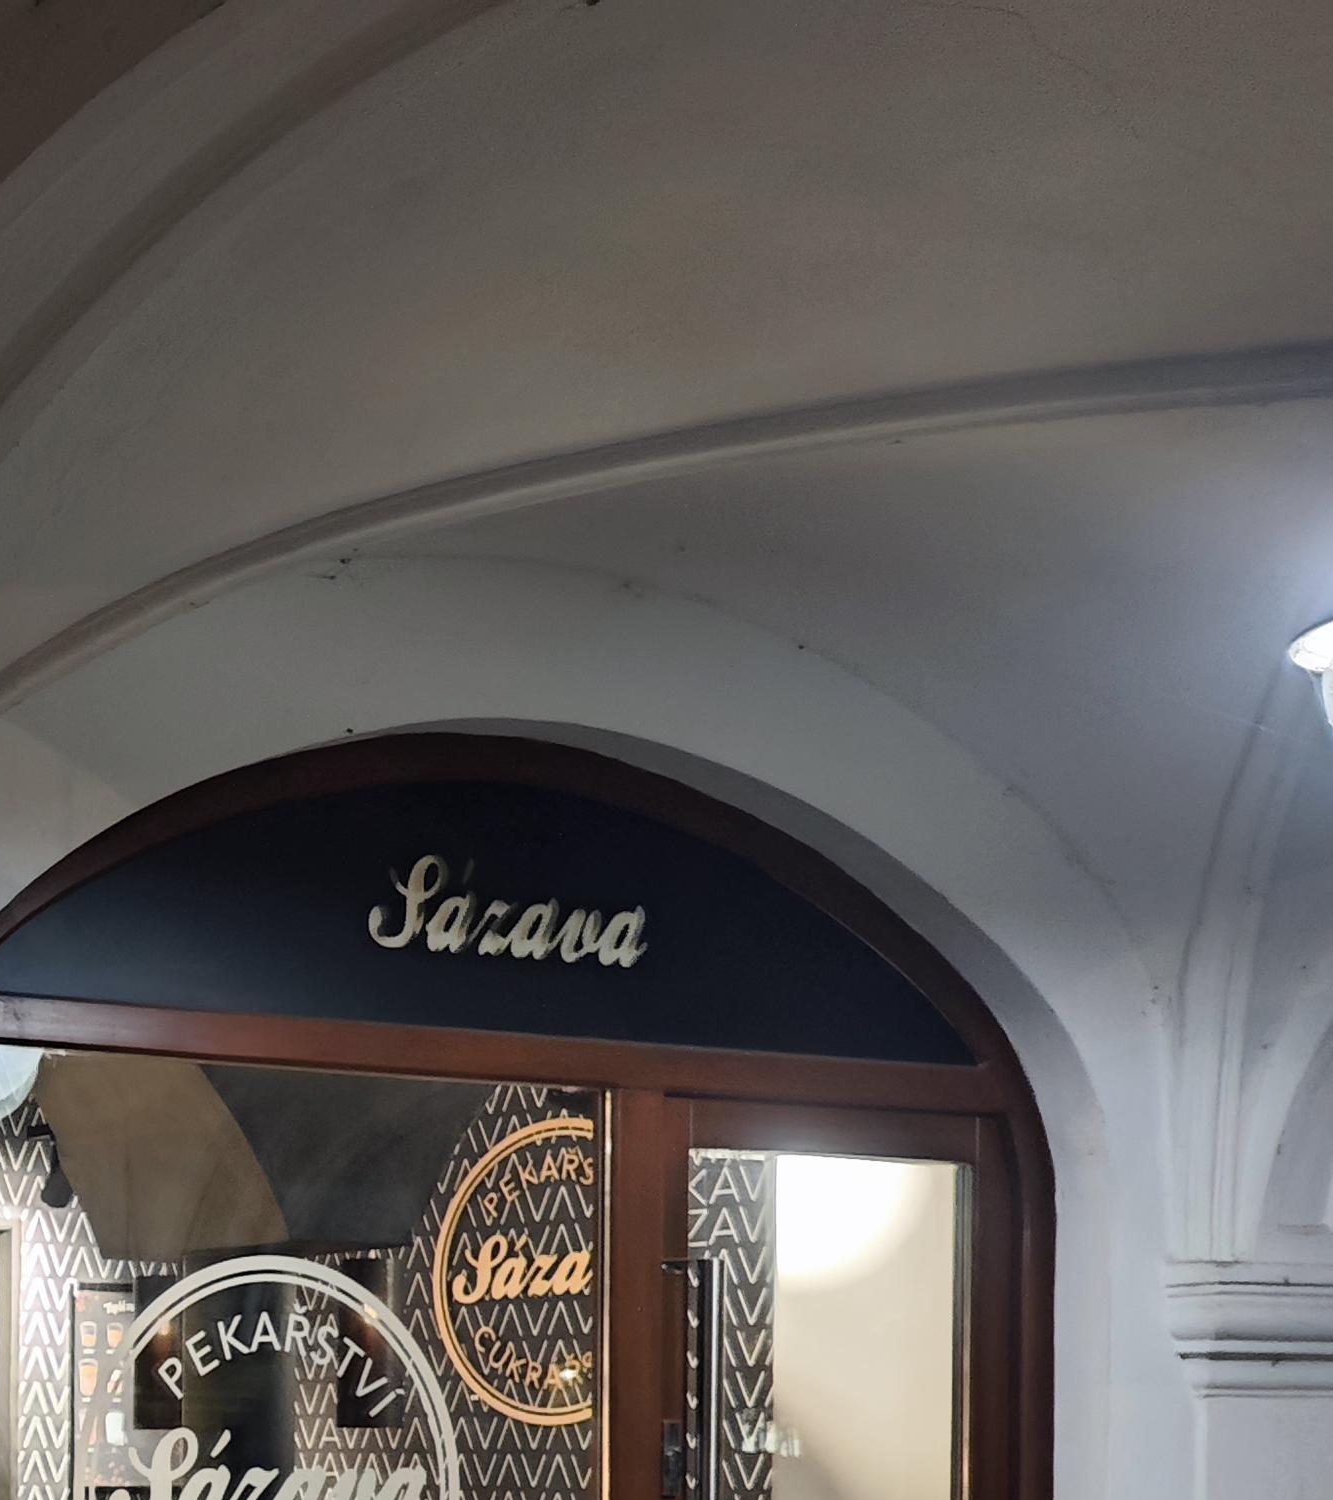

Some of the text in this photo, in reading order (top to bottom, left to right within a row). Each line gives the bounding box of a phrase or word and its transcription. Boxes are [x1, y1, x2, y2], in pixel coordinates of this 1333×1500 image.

[367, 854, 648, 968] Sázava
[482, 1146, 593, 1219] PEKAŘS
[451, 1233, 593, 1305] Sáza
[156, 1299, 407, 1419] PEKAŘSTVÍ
